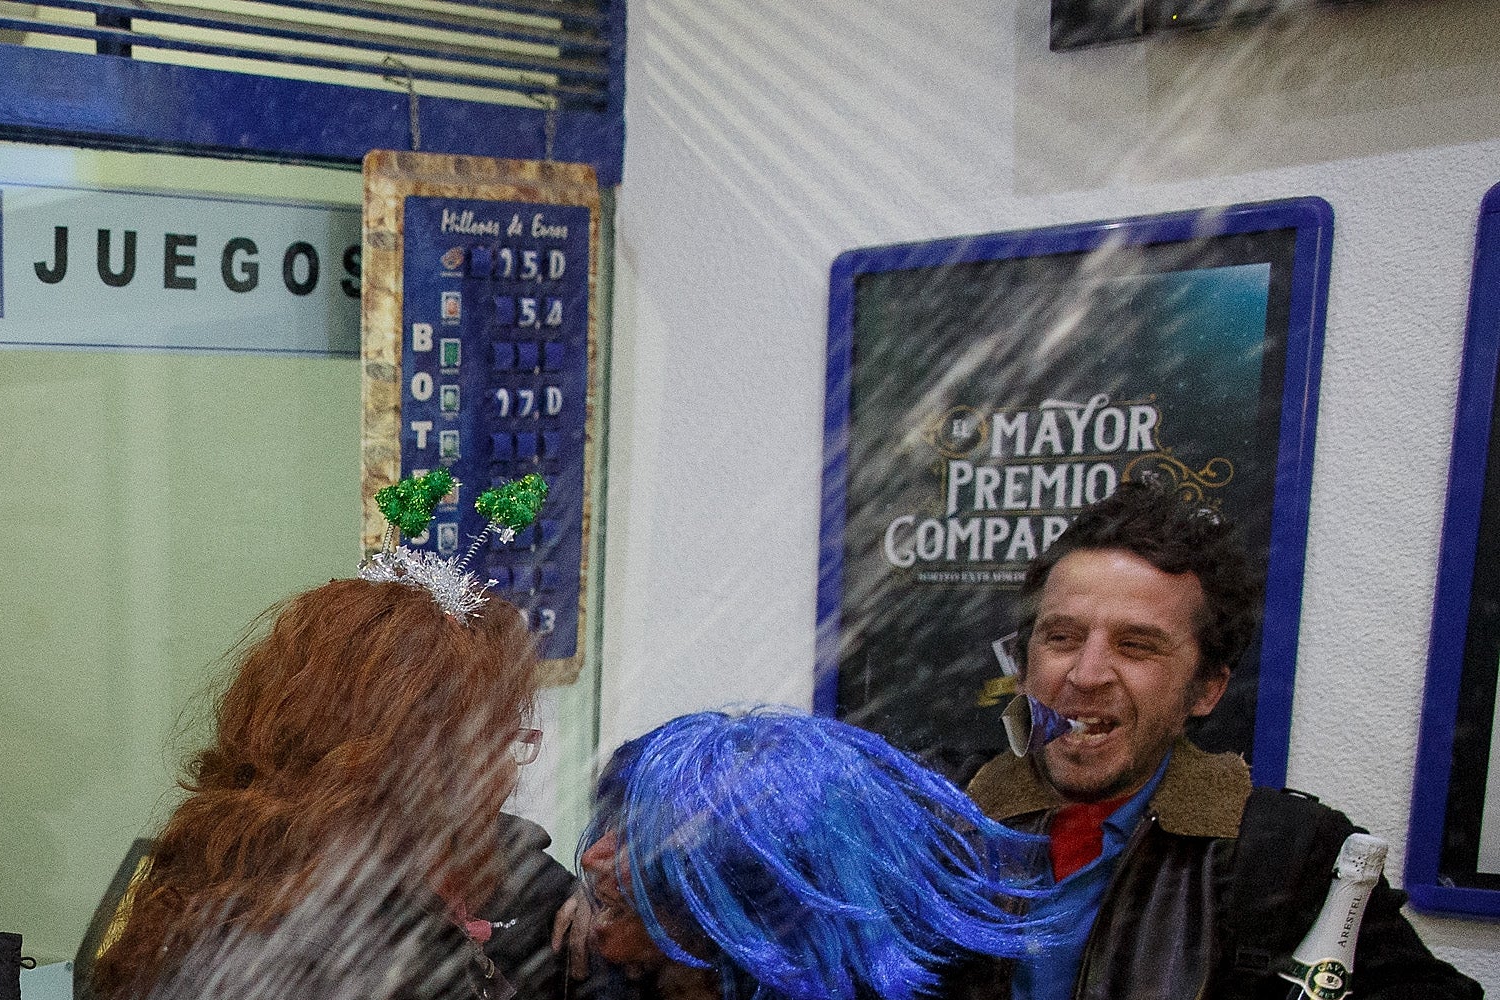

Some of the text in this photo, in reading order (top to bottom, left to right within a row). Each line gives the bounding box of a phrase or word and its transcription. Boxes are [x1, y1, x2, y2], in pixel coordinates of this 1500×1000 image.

[989, 393, 1159, 458] MAYOR
[946, 458, 1118, 518] PREMIO
[884, 512, 1078, 569] COMPAR
[1337, 894, 1363, 948] ARESTEL
